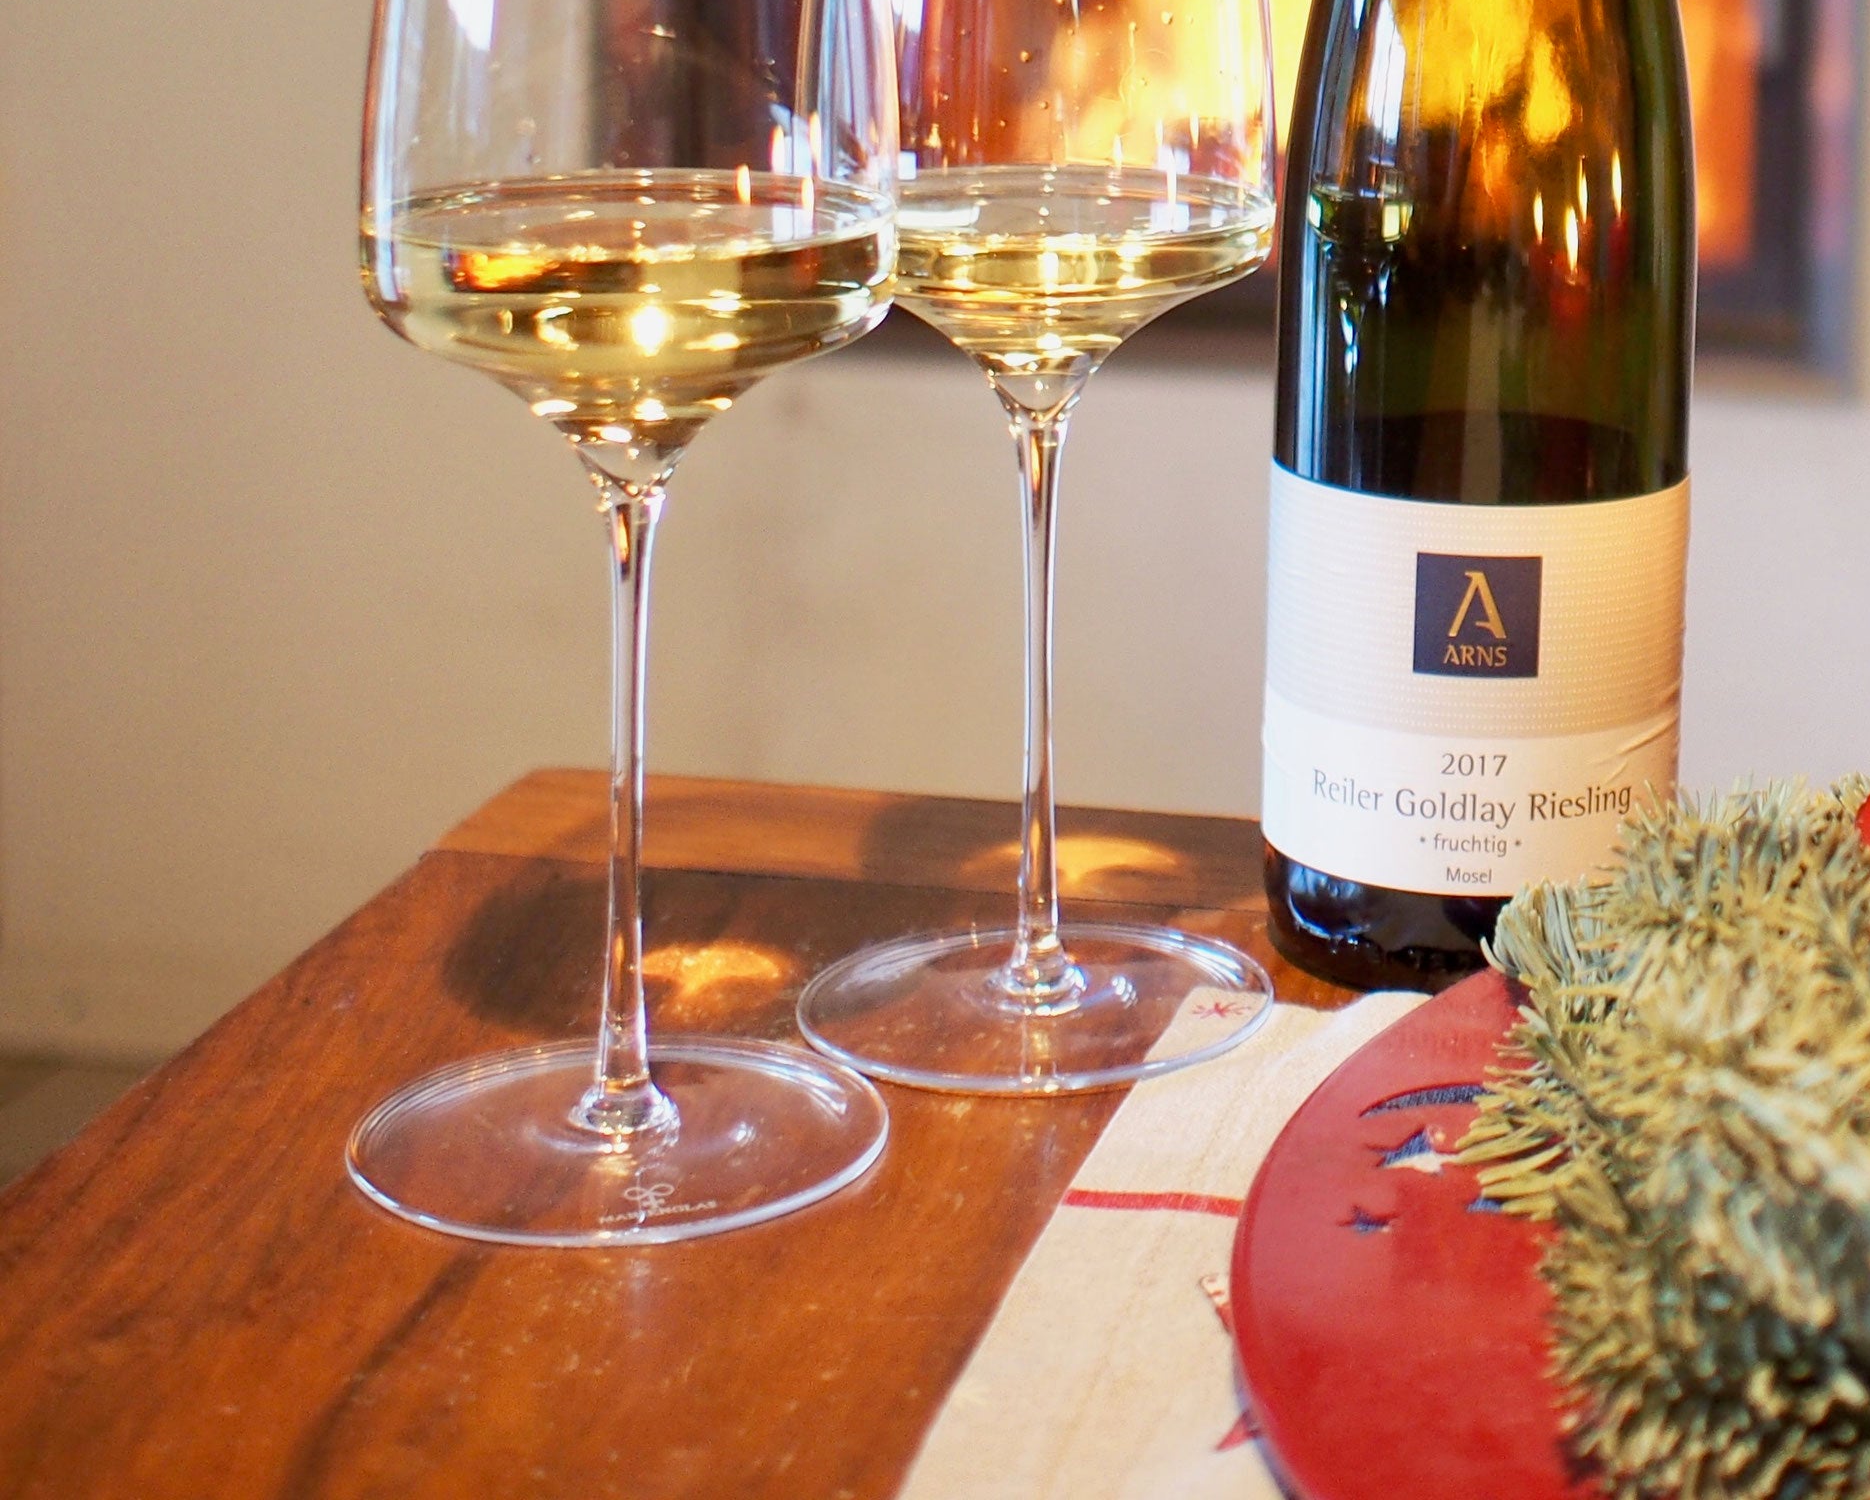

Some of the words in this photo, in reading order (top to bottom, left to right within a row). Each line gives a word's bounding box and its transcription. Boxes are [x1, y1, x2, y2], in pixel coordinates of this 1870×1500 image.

[1448, 571, 1507, 639] A
[1443, 645, 1508, 668] ARNS
[1441, 752, 1508, 777] 2017
[1313, 769, 1384, 812] Reiler
[1395, 789, 1516, 830] Goldlay
[1529, 785, 1632, 822] Riesling
[1433, 833, 1508, 857] fruchtig
[1446, 866, 1493, 884] Mosel
